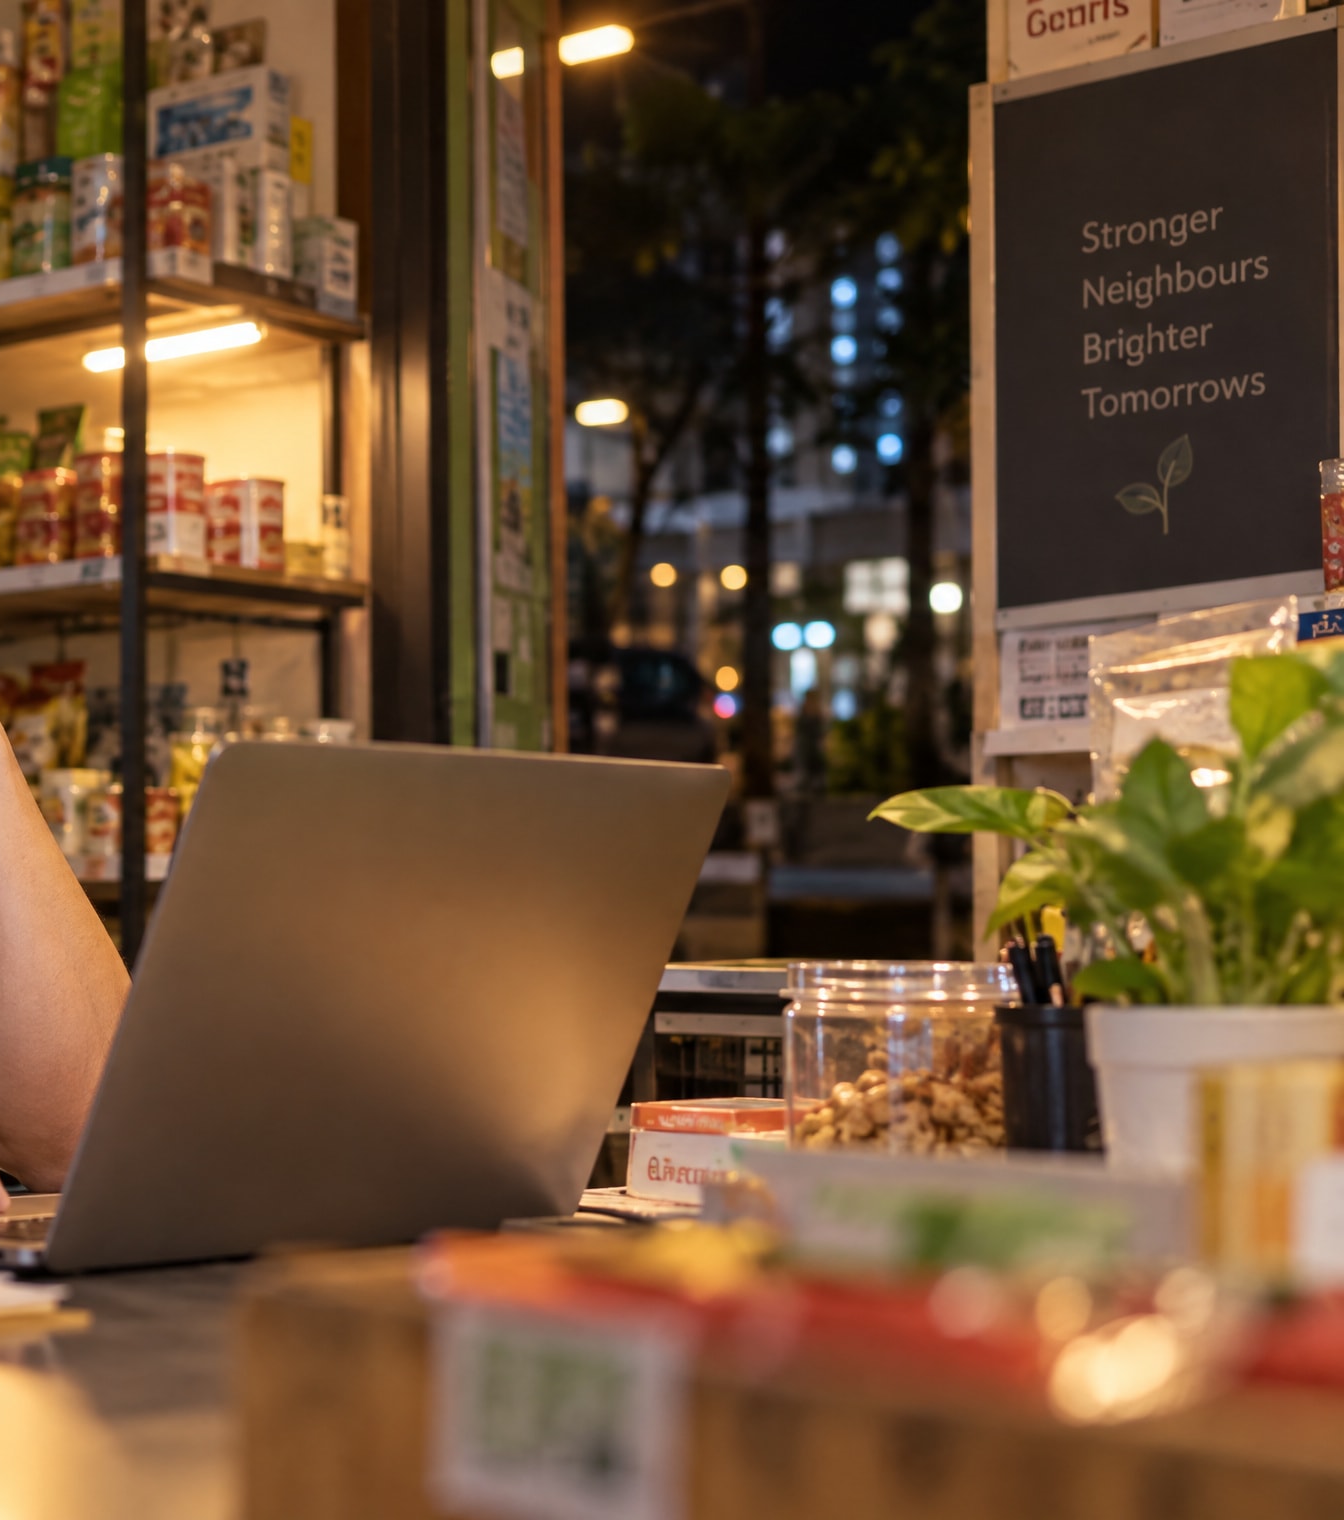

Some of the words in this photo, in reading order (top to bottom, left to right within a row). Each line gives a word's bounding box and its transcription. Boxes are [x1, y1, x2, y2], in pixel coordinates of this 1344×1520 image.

[1082, 206, 1223, 253] Stronger
[1082, 256, 1269, 309] Neighbours
[1083, 322, 1213, 367] Brighter
[1081, 372, 1266, 419] Tomorrows
